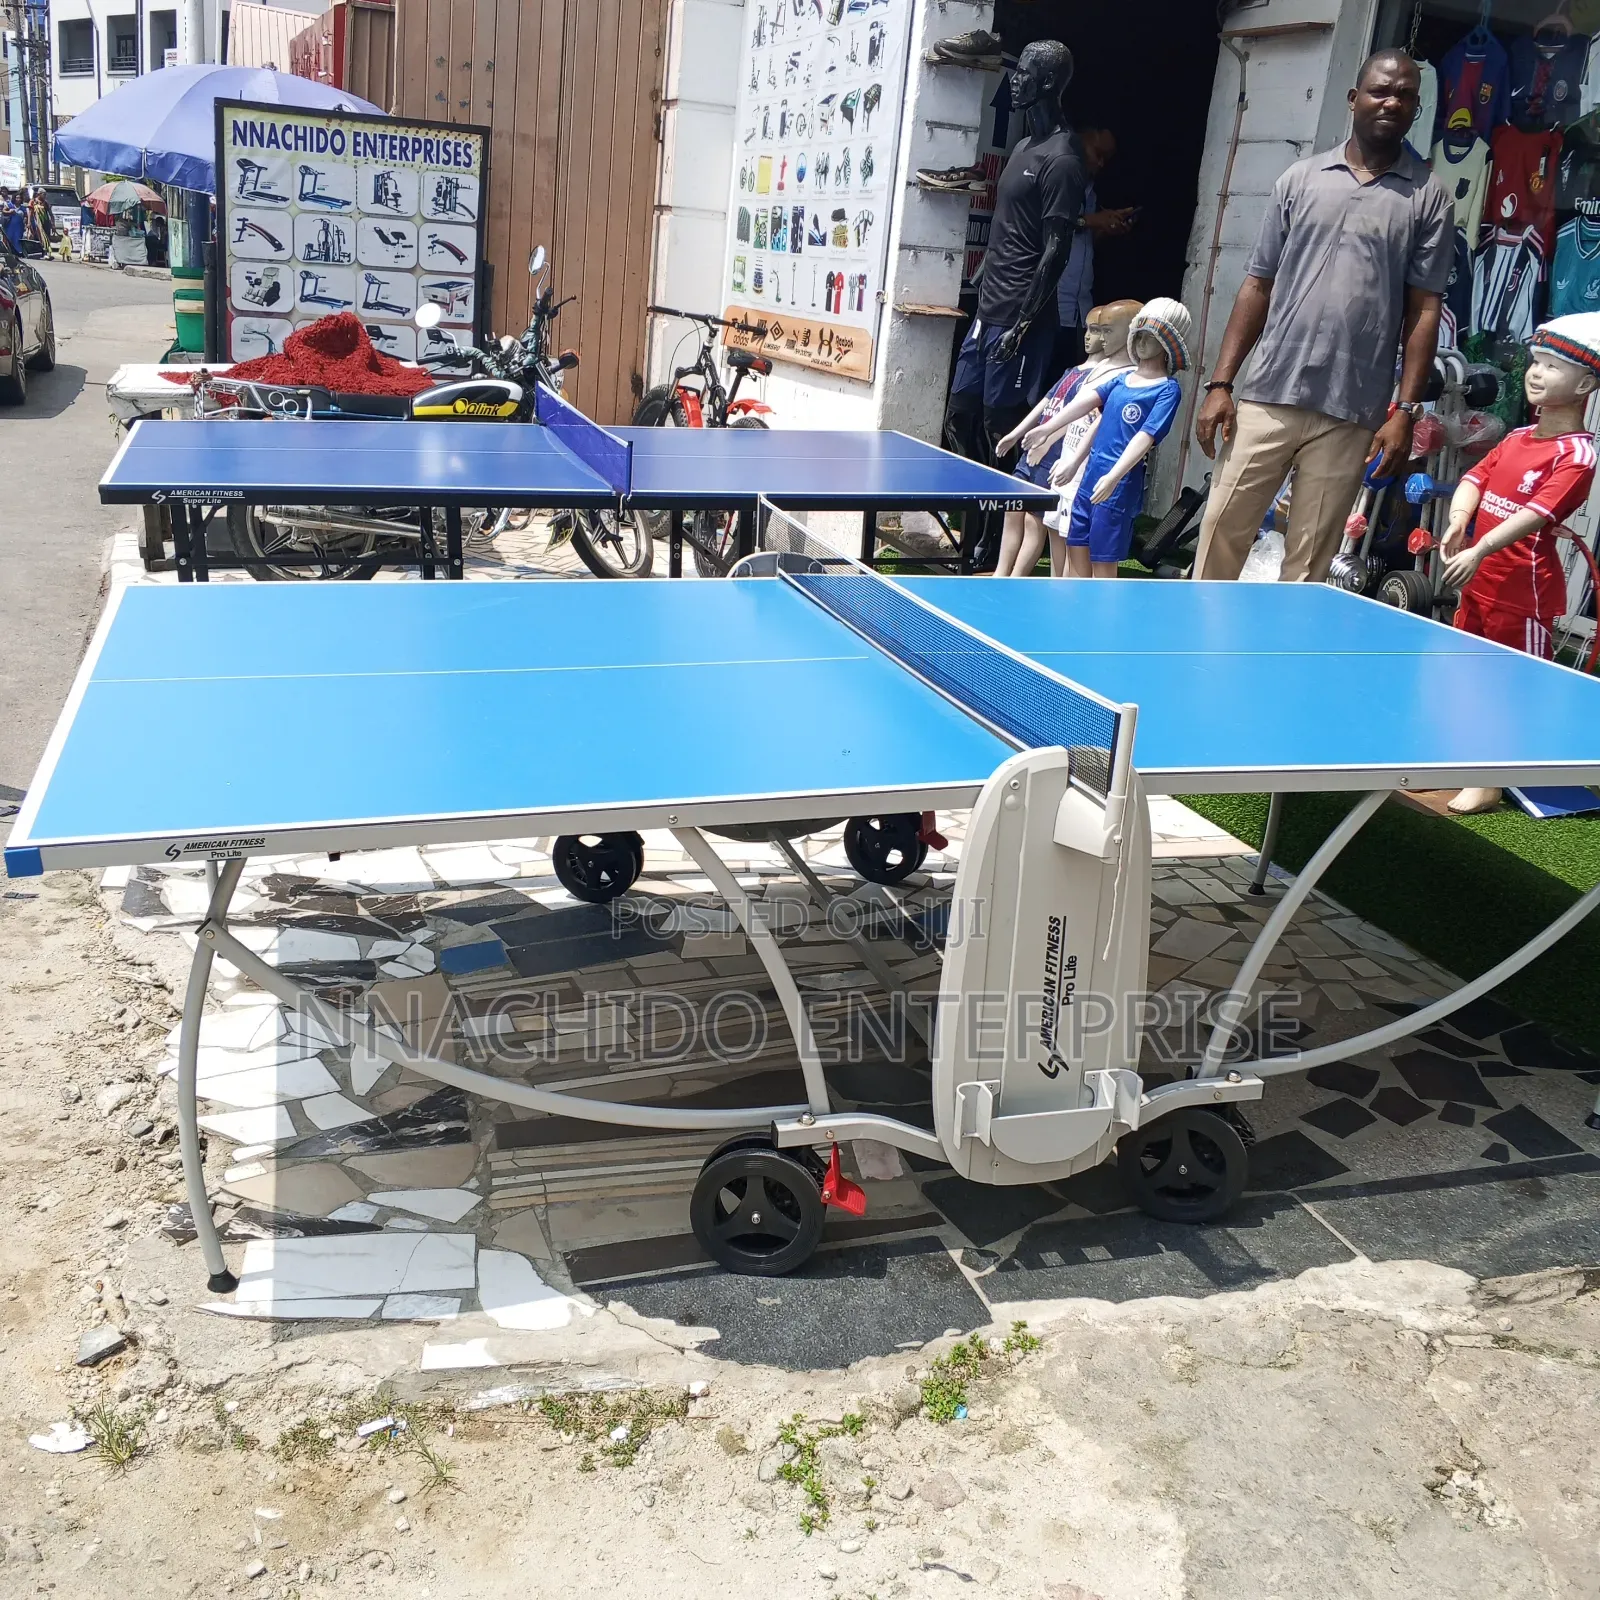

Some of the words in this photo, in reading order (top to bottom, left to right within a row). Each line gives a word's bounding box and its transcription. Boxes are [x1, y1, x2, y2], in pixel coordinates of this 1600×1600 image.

[232, 119, 346, 156] NNACHIDO
[352, 130, 473, 169] ENTERPRISES
[466, 402, 502, 416] Qlink
[182, 497, 205, 505] Super
[979, 499, 1024, 511] VN-113
[183, 839, 229, 850] AMERICAN
[229, 837, 266, 847] FITNESS
[210, 851, 226, 859] Pro
[1046, 915, 1061, 976] FITNESS
[1064, 954, 1078, 981] Lite
[1062, 983, 1076, 1007] Pro
[1040, 977, 1057, 1051] AMERICAN
